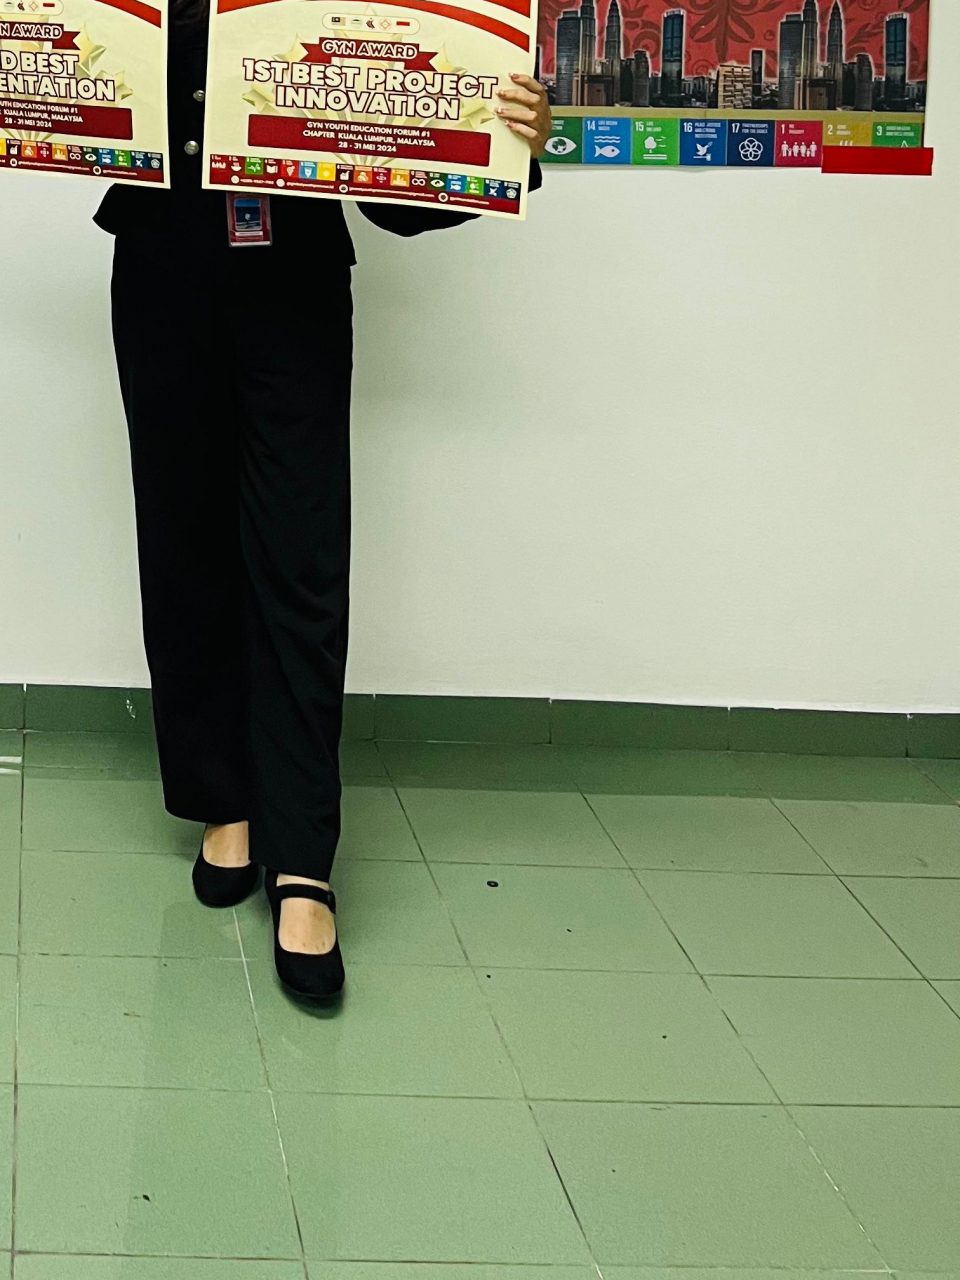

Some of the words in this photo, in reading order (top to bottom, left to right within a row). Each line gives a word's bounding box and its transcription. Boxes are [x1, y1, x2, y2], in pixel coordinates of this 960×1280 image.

[12, 24, 64, 39] AWARD
[321, 40, 356, 56] GYN
[357, 42, 418, 60] AWARD
[19, 51, 79, 76] BEST
[242, 57, 289, 84] 1ST
[290, 62, 360, 89] BEST
[367, 67, 499, 99] PROJECT
[12, 101, 47, 111] EDUCATION
[47, 105, 69, 113] FORUM
[275, 85, 460, 120] INNOVATION
[3, 108, 24, 117] KUALA
[51, 114, 83, 123] MALAYSIA
[36, 120, 52, 128] 2024
[306, 121, 323, 129] GYN
[324, 122, 349, 131] YOUTH
[350, 124, 392, 135] EDUCATION
[393, 128, 420, 137] FORUM
[586, 120, 596, 131] 14
[635, 121, 644, 131] 15
[683, 122, 693, 132] 16
[731, 122, 740, 133] 17
[876, 125, 883, 136] 3
[302, 130, 335, 139] CHAPTER
[338, 132, 363, 141] KUALA
[363, 134, 396, 144] LUMPUR,
[396, 137, 436, 147] MALAYSIA
[362, 143, 375, 151] MEI
[376, 144, 397, 152] 2024
